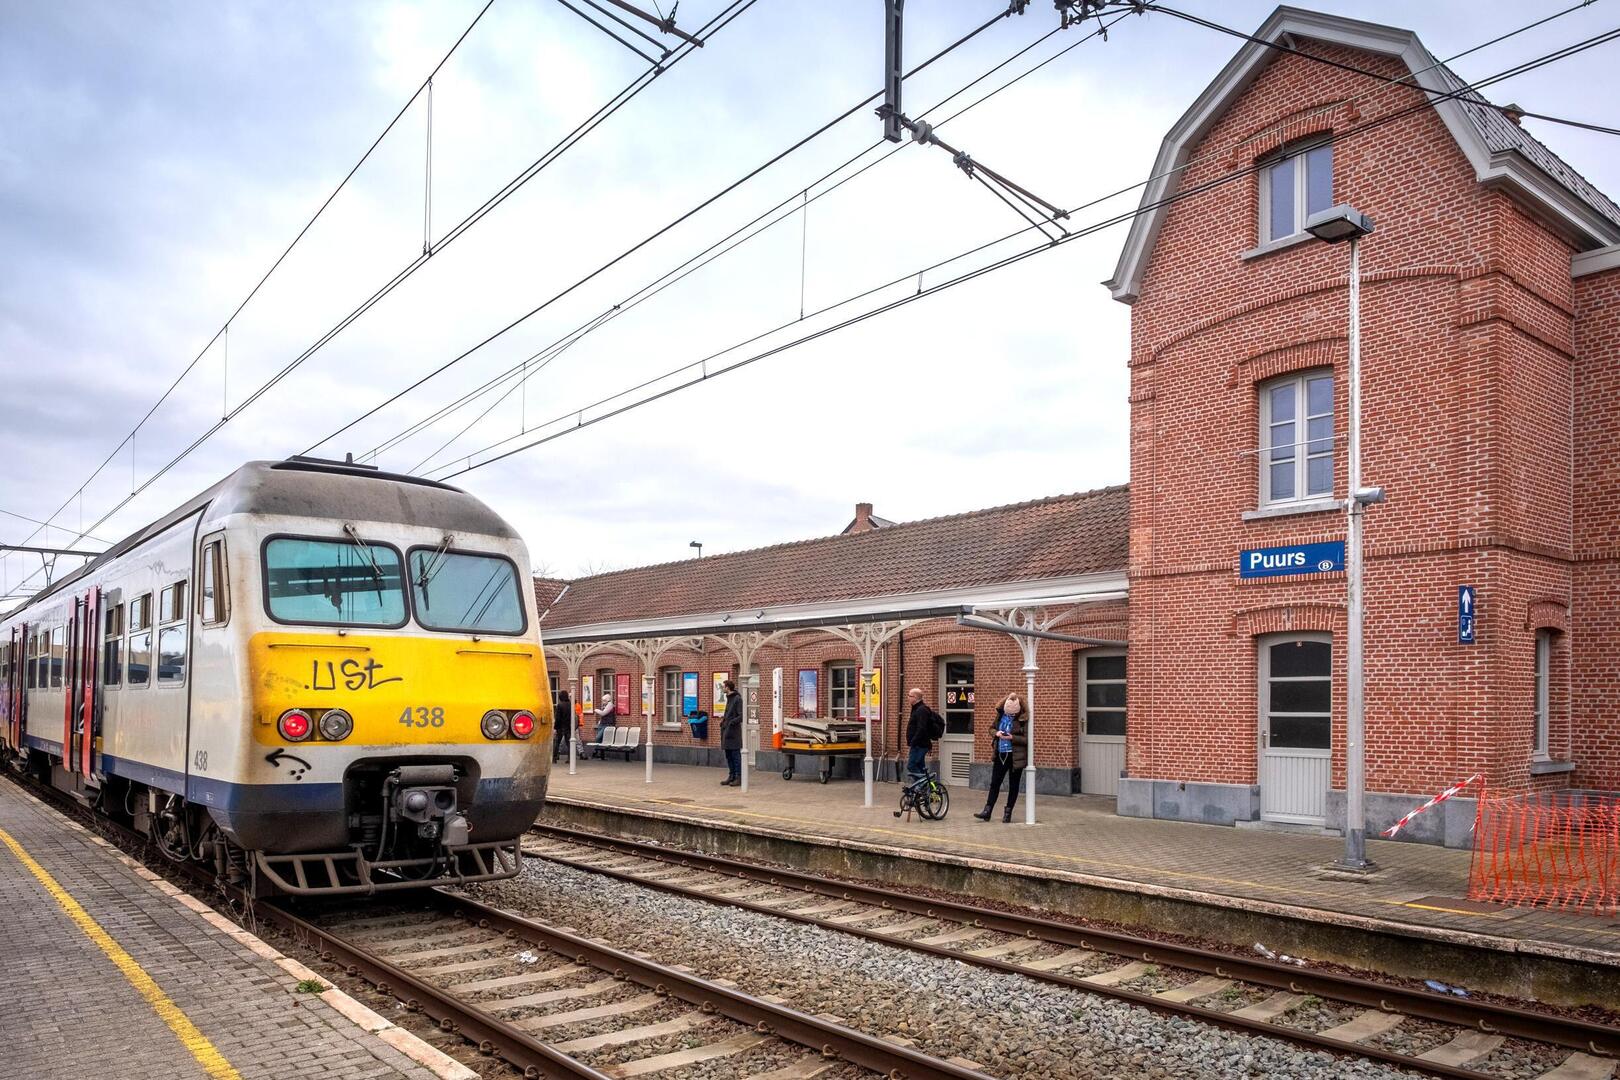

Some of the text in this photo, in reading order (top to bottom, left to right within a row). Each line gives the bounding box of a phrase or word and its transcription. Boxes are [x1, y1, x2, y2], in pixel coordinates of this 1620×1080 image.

[1250, 552, 1305, 569] Puurs
[399, 707, 445, 728] 438
[194, 750, 208, 771] 438
